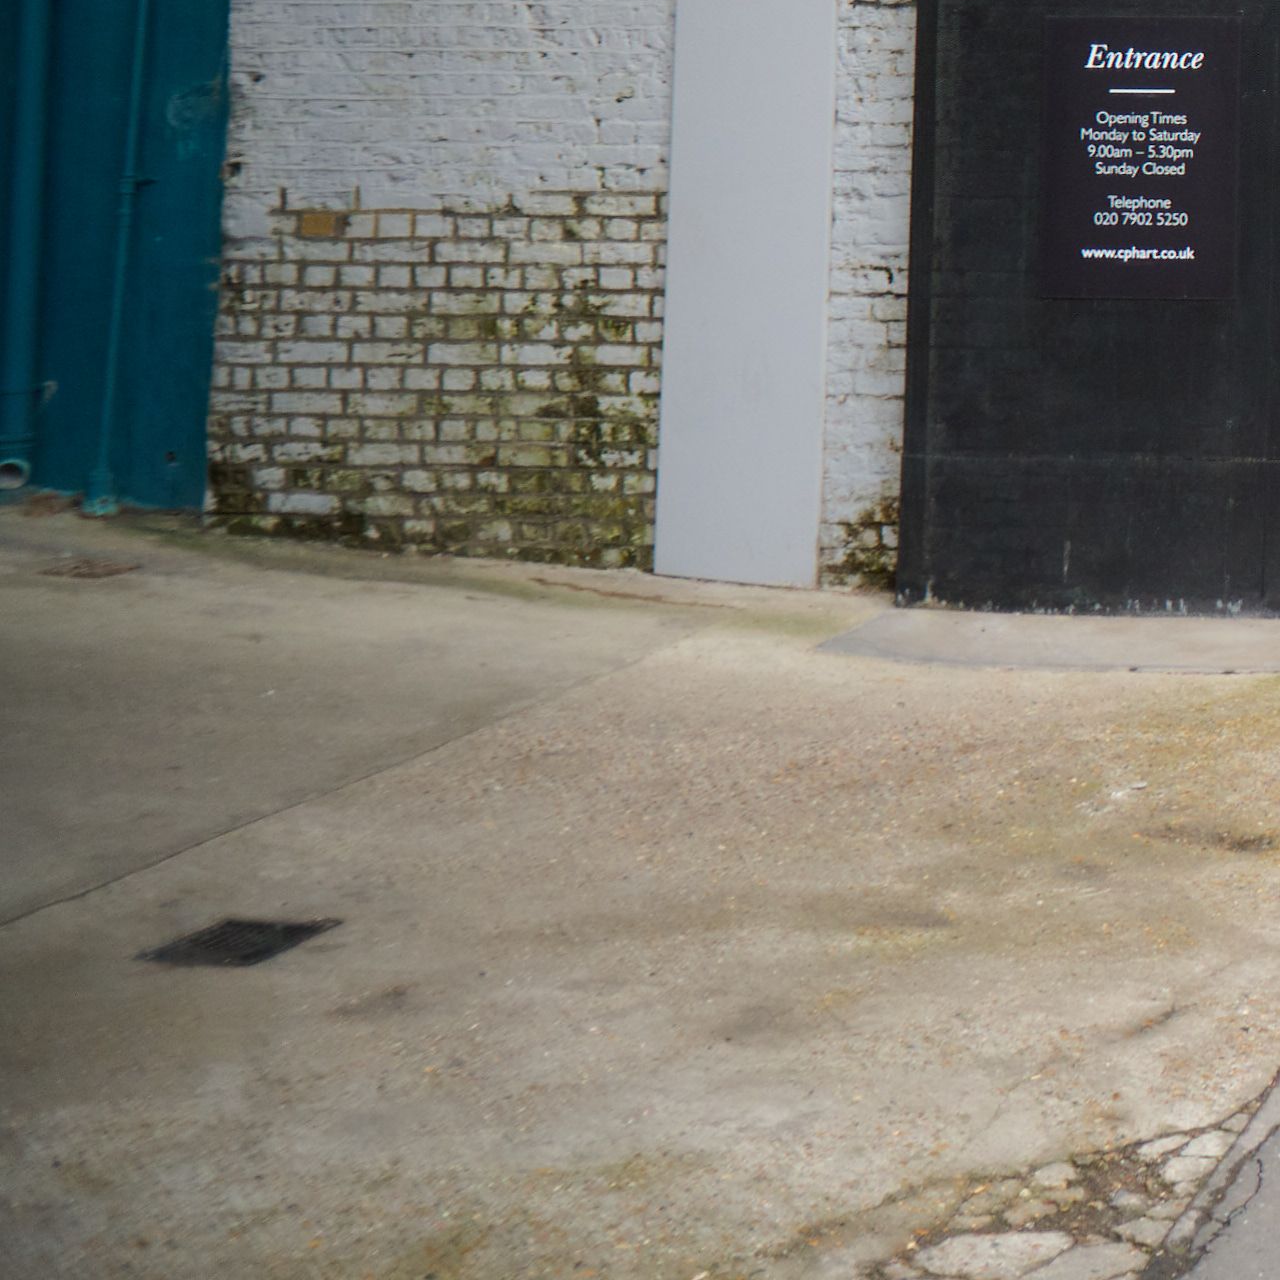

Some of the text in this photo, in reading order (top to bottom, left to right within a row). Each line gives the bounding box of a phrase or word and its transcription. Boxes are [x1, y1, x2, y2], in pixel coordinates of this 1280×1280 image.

[1084, 43, 1205, 70] Entrance
[1095, 111, 1188, 128] Opening Times
[1080, 128, 1201, 144] Monday to Saturday
[1087, 144, 1133, 159] 9.00am
[1147, 144, 1194, 160] 5.30pm
[1095, 162, 1186, 178] Sunday Closed
[1107, 195, 1172, 211] Telephone
[1093, 212, 1188, 226] 020 7902 5250
[1081, 246, 1195, 262] www.cphart.co.uk
